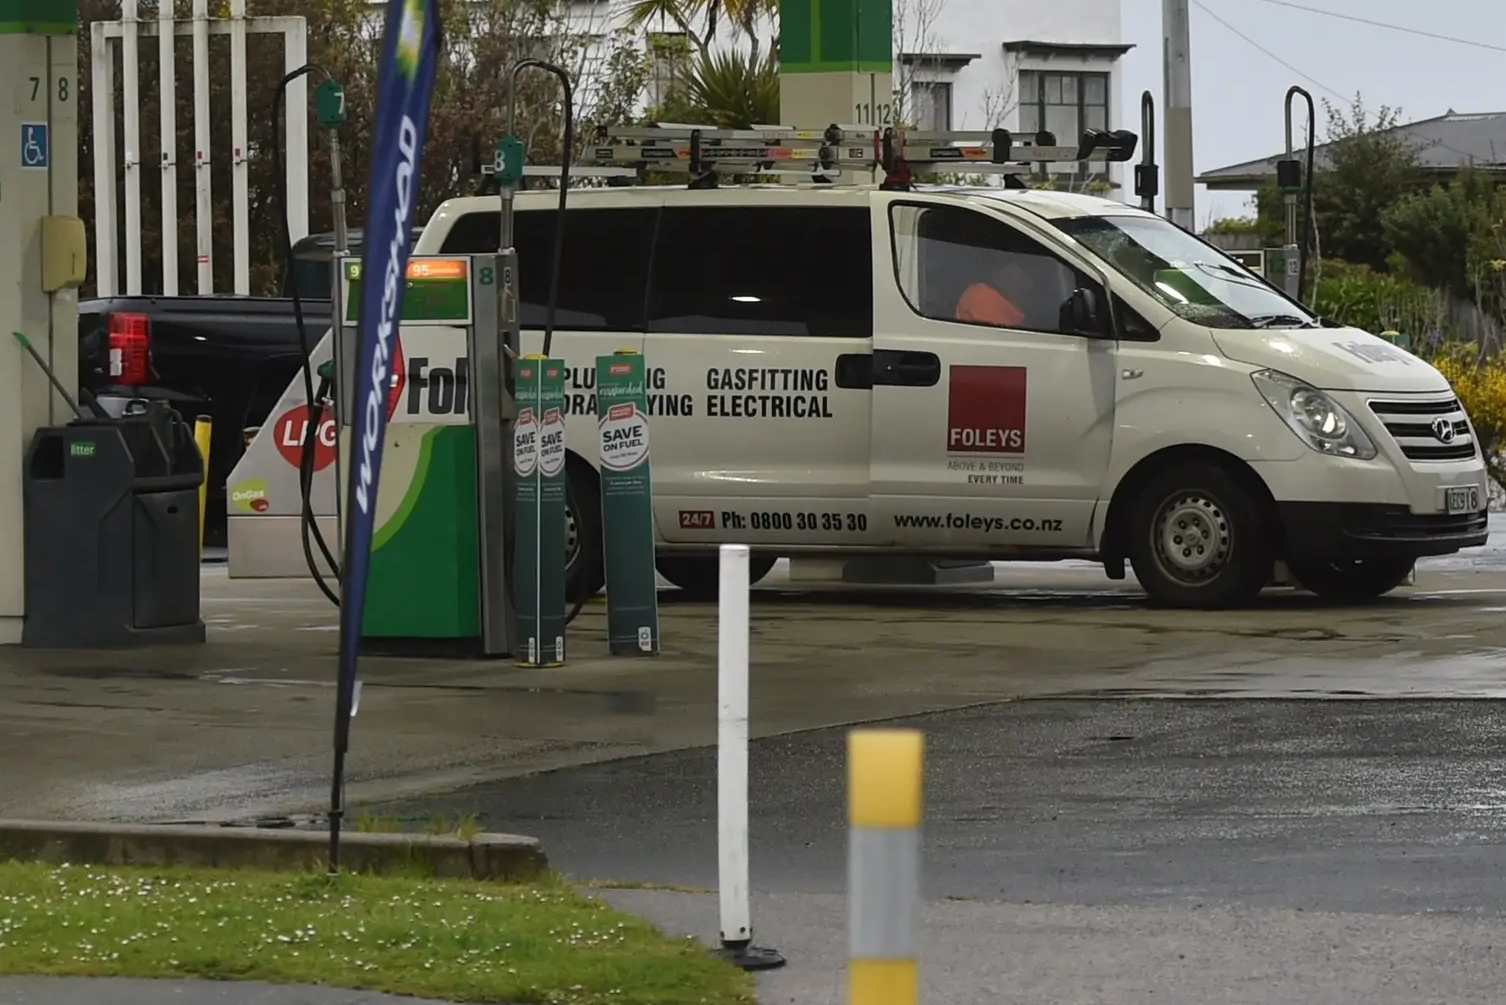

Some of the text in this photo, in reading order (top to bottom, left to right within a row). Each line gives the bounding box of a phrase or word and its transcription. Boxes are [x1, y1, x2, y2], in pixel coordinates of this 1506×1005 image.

[29, 77, 40, 101] 7
[58, 77, 69, 102] 8
[334, 92, 345, 114] 7
[855, 103, 870, 124] 11
[877, 104, 891, 125] 12
[493, 149, 506, 172] 8
[413, 264, 430, 277] 95
[479, 267, 494, 286] 8
[707, 368, 828, 392] GASFITTING
[707, 395, 833, 418] ELECTRICAL
[516, 431, 536, 448] SAVE
[541, 430, 563, 448] SAVE
[603, 425, 643, 443] SAVE
[950, 428, 1022, 447] FOLEYS
[603, 438, 644, 452] ON FUEL
[947, 461, 1024, 473] ABOVE & BEYOND
[967, 474, 1024, 485] EVERY TIME
[682, 513, 713, 527] 24/7
[721, 511, 868, 531] Ph: 0800 30 35 30
[894, 512, 1063, 533] www.foleys.co.nz
